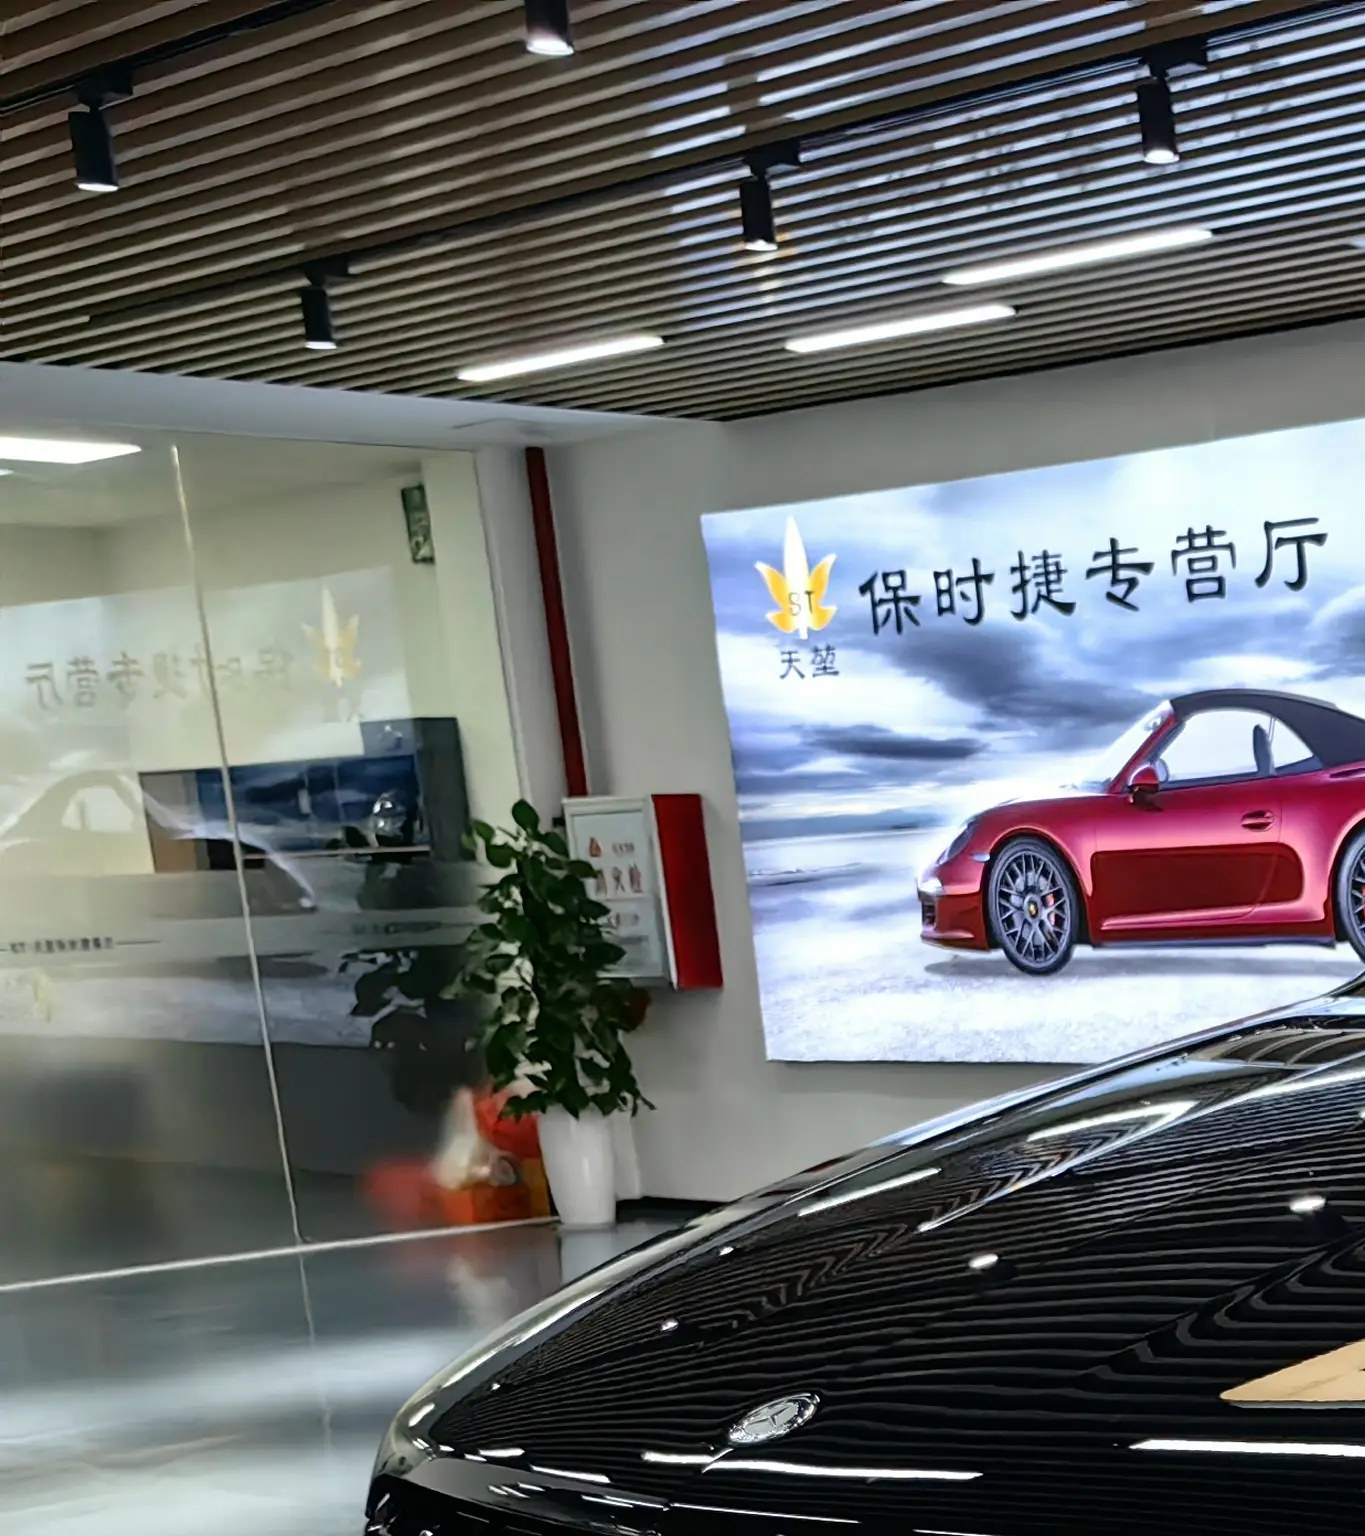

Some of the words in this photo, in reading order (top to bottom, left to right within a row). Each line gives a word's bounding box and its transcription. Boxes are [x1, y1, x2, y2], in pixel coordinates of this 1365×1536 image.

[859, 517, 1329, 636] 保时捷专营厅
[787, 589, 816, 617] ST
[779, 643, 841, 680] 天堃
